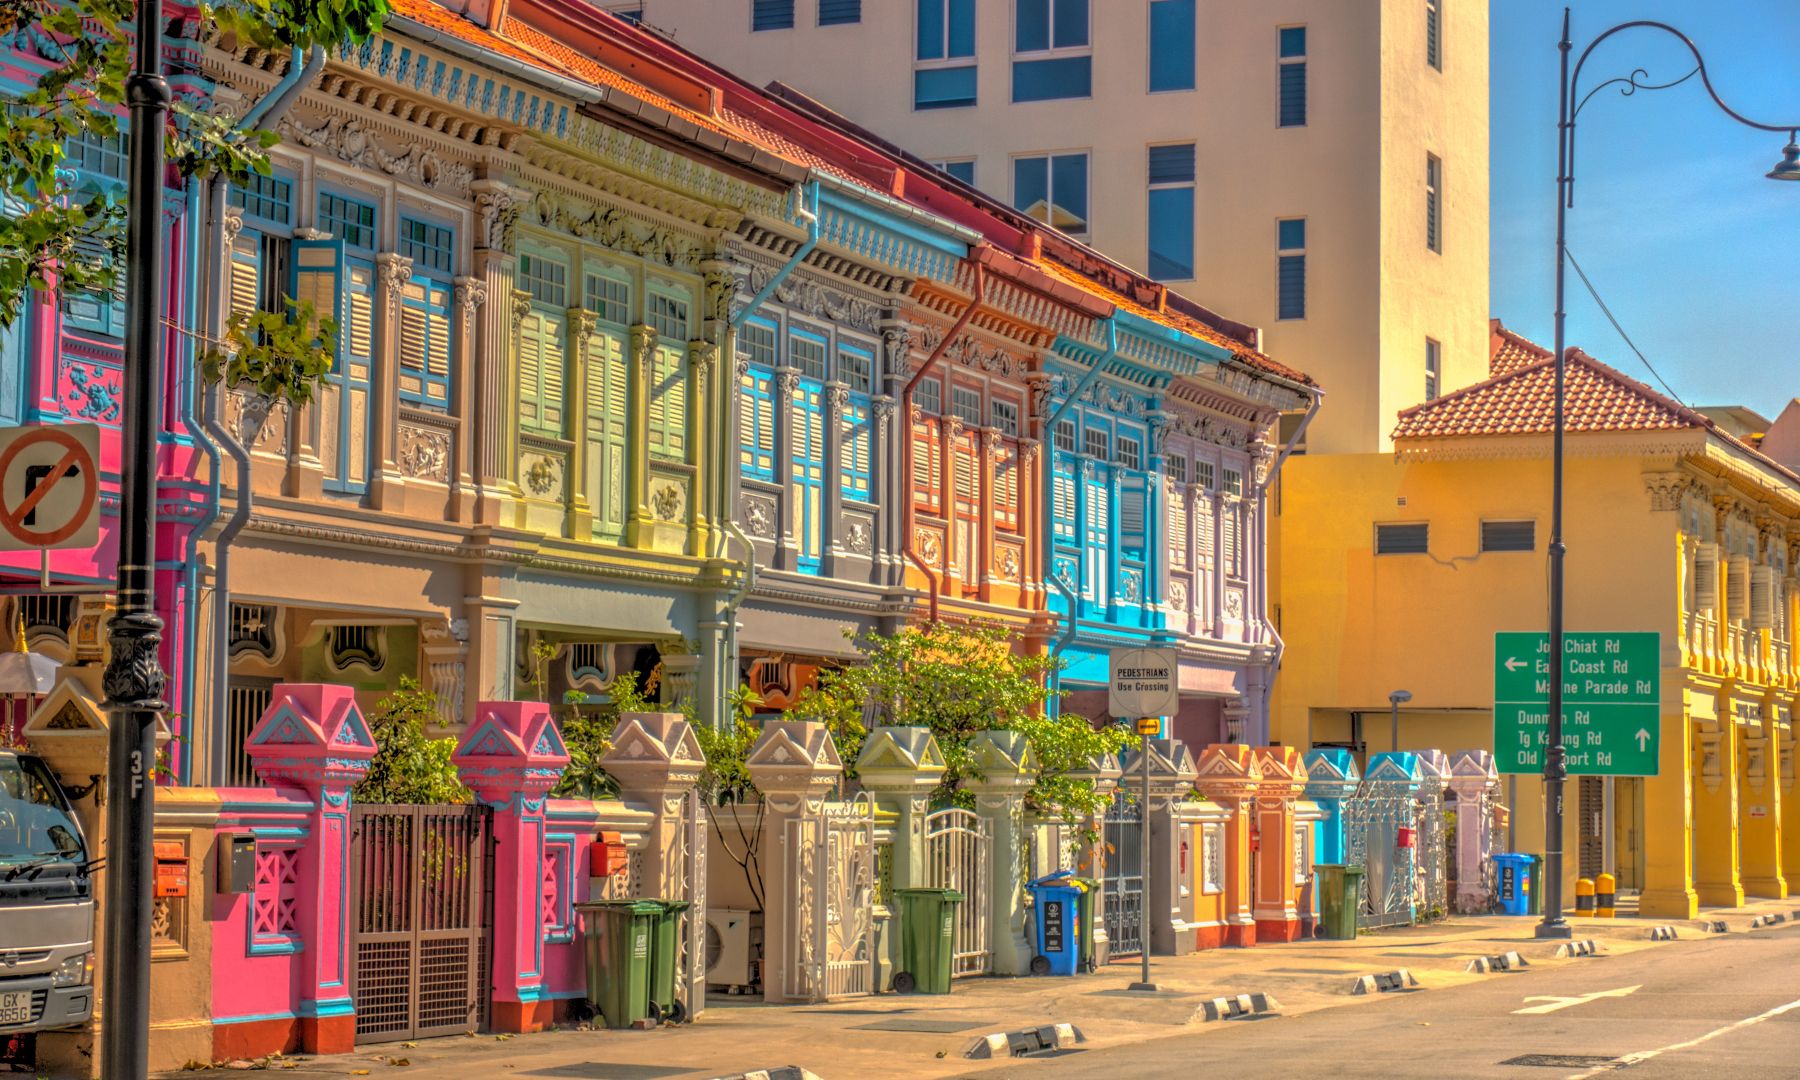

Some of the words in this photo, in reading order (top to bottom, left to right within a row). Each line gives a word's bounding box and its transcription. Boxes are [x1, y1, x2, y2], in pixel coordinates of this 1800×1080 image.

[1536, 639, 1551, 654] Jo
[1565, 639, 1597, 654] Chiat
[1605, 640, 1620, 654] Rd
[1117, 668, 1169, 678] PEDESTRIANS
[1570, 659, 1606, 674] Coast
[1613, 660, 1628, 674] Rd
[1117, 682, 1132, 691] Use
[1135, 682, 1169, 692] Crossing
[1535, 680, 1578, 694] Mane
[1585, 680, 1629, 694] Parade
[1636, 680, 1651, 694] Rd
[1518, 710, 1567, 725] Dunmn
[1575, 711, 1590, 725] Rd
[1518, 730, 1530, 748] Tg
[1587, 731, 1602, 746] Rd
[1517, 751, 1537, 765] Old
[1597, 752, 1612, 766] Rd
[131, 750, 143, 799] 3F
[4, 993, 18, 1008] GX
